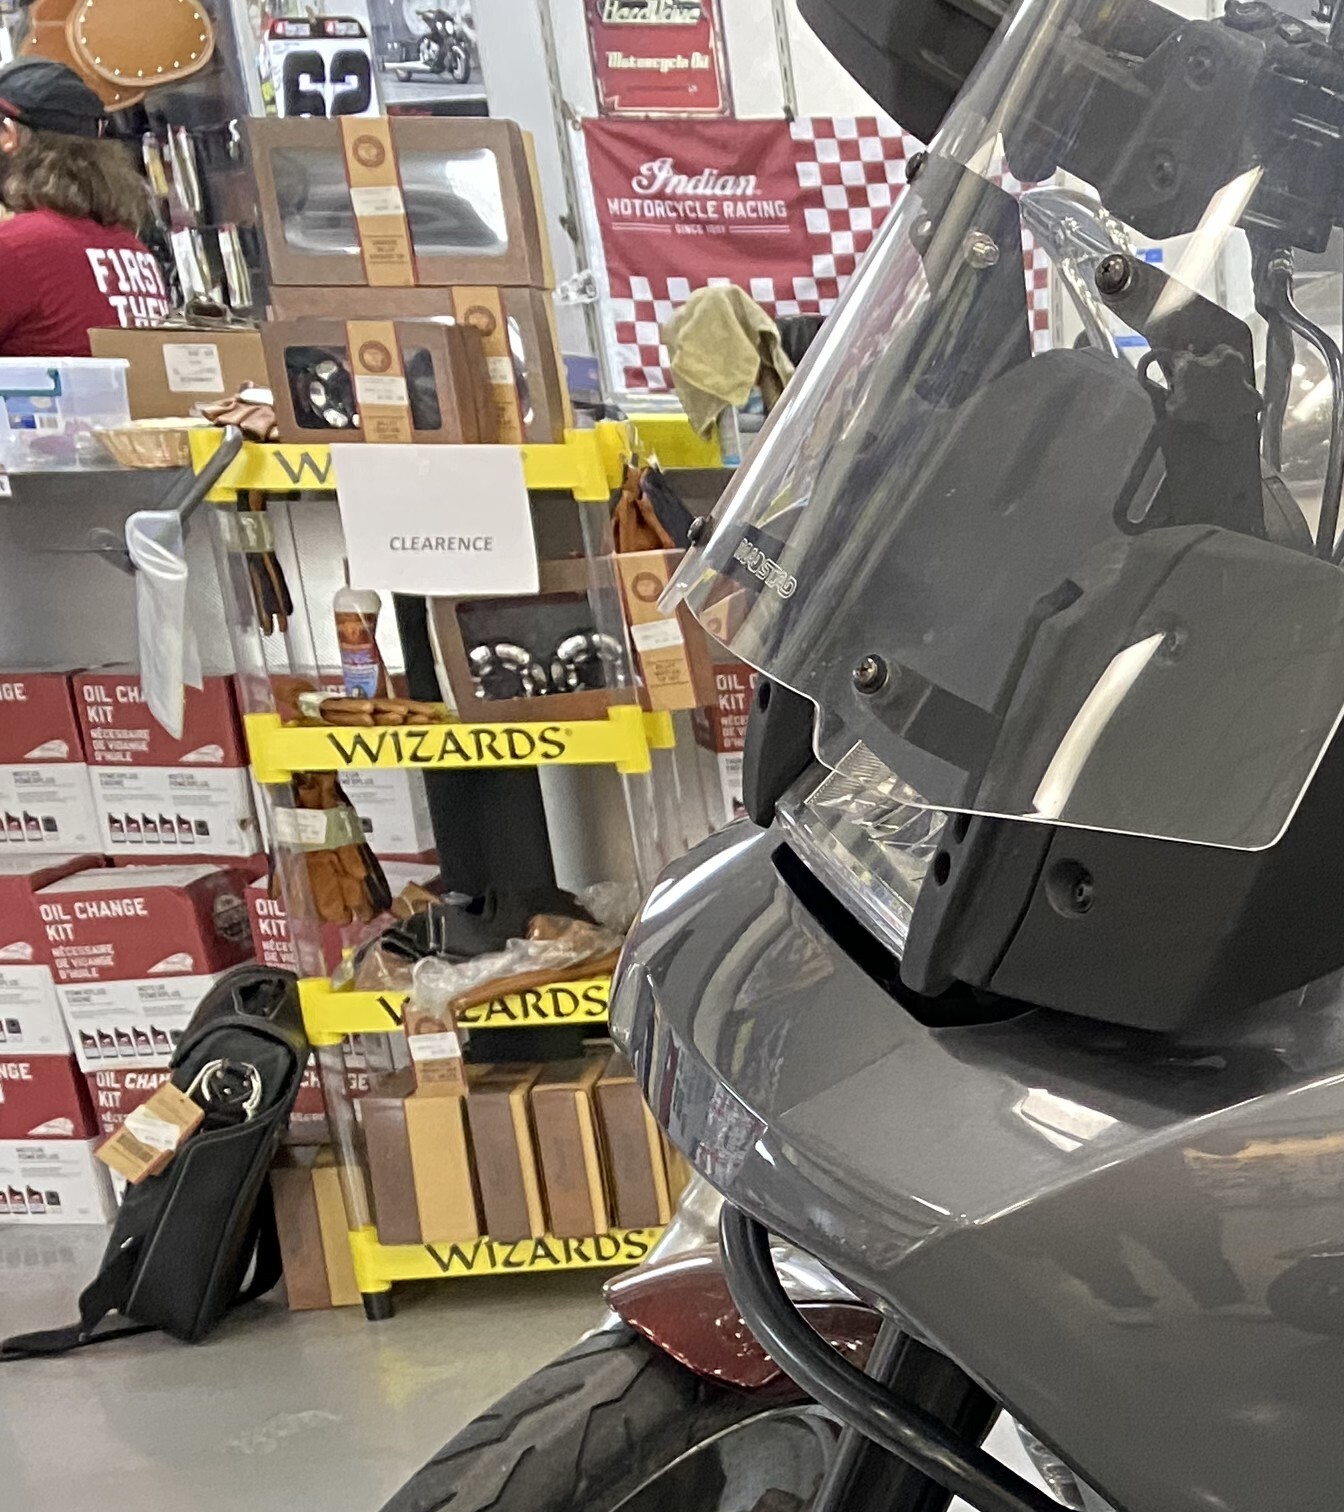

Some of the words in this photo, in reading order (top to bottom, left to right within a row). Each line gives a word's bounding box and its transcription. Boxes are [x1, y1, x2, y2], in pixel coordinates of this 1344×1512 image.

[631, 157, 757, 196] Indian
[607, 198, 719, 219] MOTORCYCLE
[723, 200, 787, 218] RACING
[389, 535, 494, 551] CLEARENCE
[733, 537, 798, 599] MADSTAD
[716, 674, 745, 690] OIL
[83, 685, 113, 702] OIL
[718, 694, 745, 711] KIT
[86, 705, 114, 723] KIT
[326, 726, 566, 765] WIZARDS
[39, 903, 71, 922] OIL
[73, 897, 149, 919] CHANGE
[255, 899, 286, 917] OIL
[45, 923, 75, 942] KIT
[258, 919, 287, 938] KIT
[377, 984, 608, 1027] ARDS
[0, 1063, 33, 1080] NGE
[96, 1071, 121, 1088] OIL
[124, 1072, 171, 1089] CHAN
[98, 1091, 121, 1108] KIT
